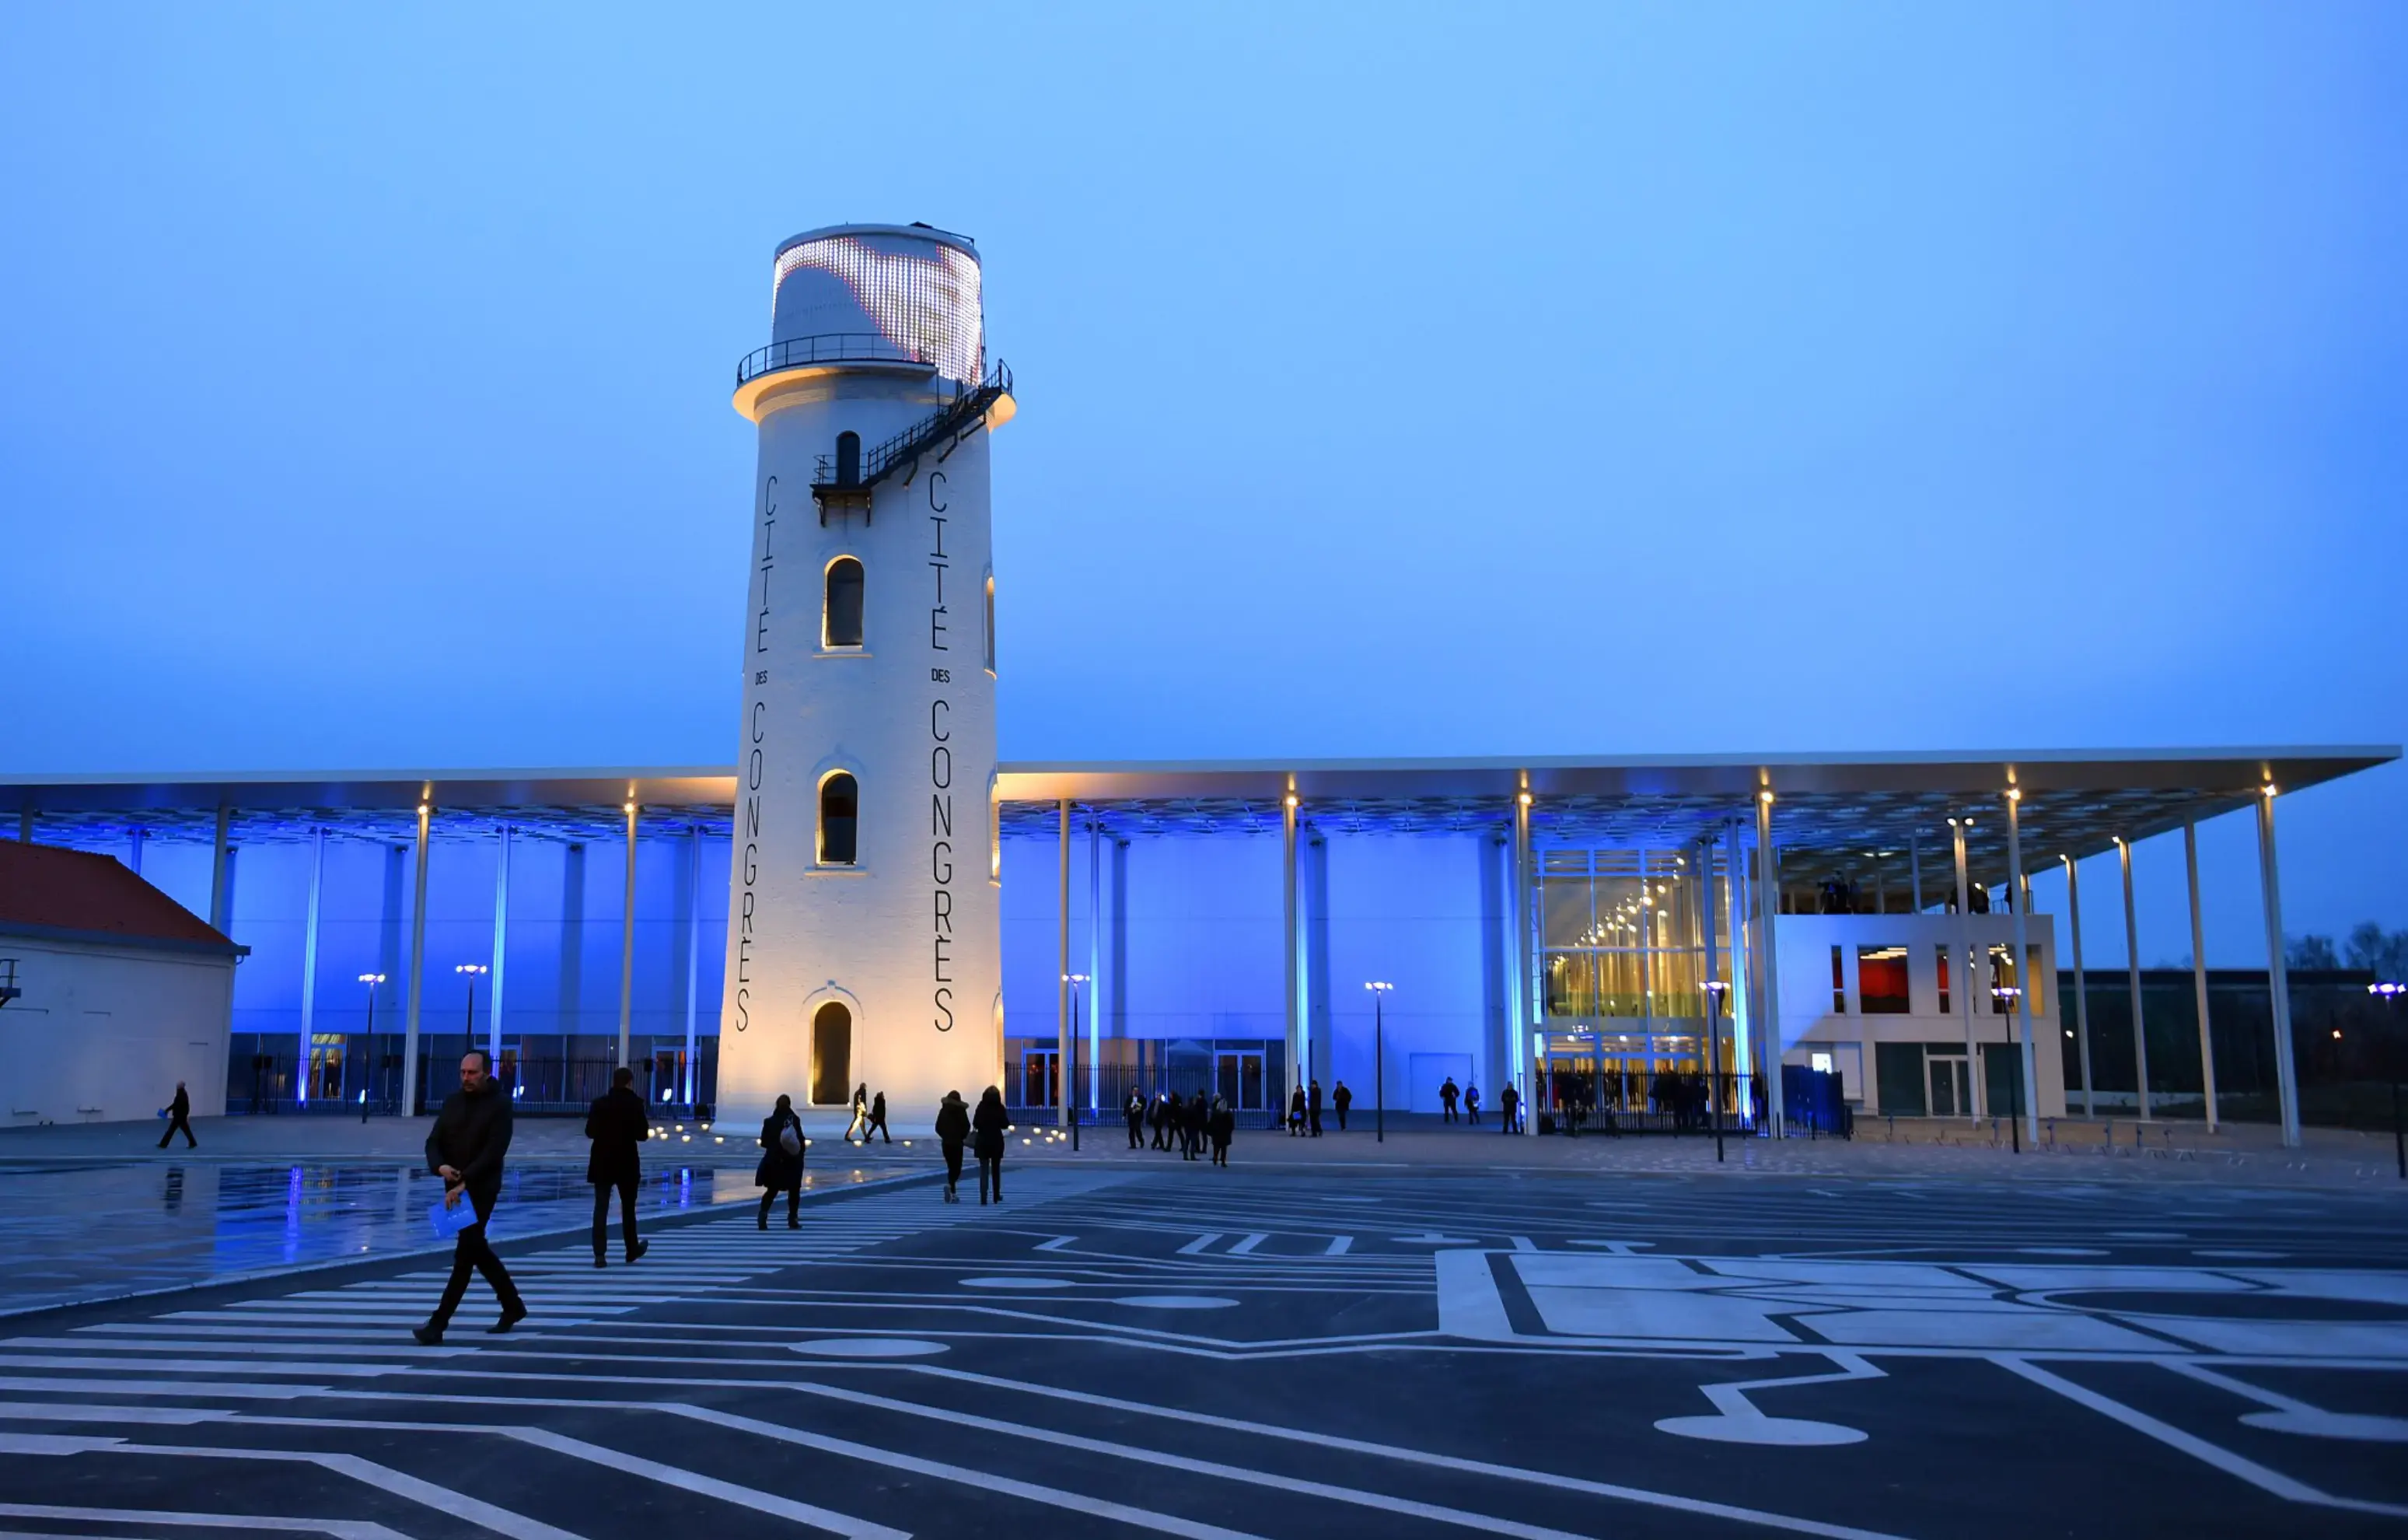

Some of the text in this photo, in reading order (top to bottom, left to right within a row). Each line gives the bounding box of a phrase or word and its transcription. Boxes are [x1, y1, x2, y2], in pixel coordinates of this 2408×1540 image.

[736, 475, 778, 1032] CITÉ DES CONGRÈS
[928, 471, 952, 1032] CITÉ DES CONGRÈS
